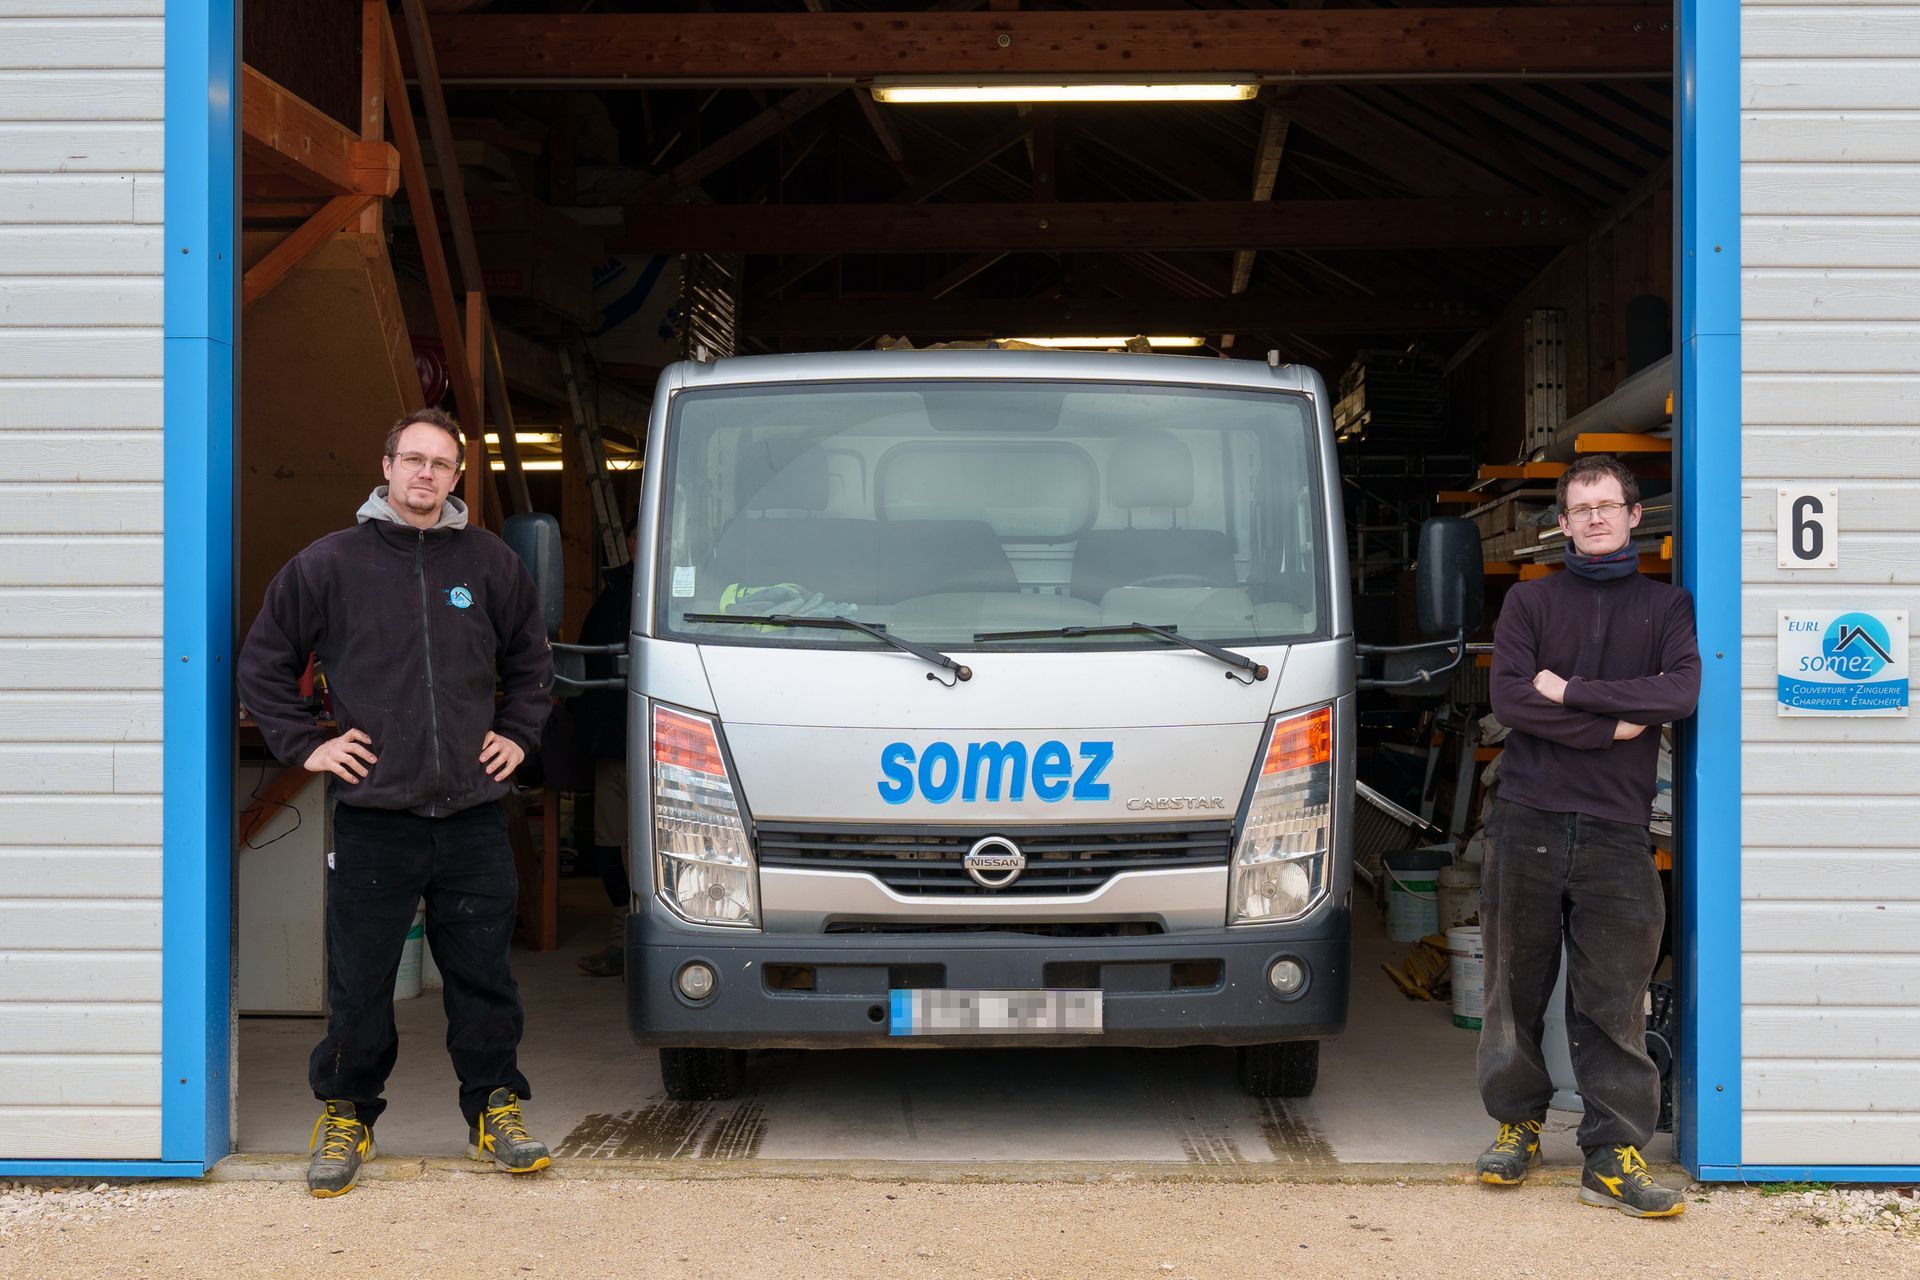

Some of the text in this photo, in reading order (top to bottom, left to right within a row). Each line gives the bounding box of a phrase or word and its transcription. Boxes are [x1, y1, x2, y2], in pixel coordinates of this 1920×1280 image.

[1792, 495, 1824, 561] 6
[1788, 621, 1820, 632] EURL
[1799, 655, 1875, 672] somez
[1792, 685, 1901, 695] COUVERTURE ZINGUERIE
[1792, 694, 1902, 706] CHARPENTE ÉTANCHÉITÉ
[877, 740, 1114, 805] somez
[1126, 795, 1226, 810] CABSTAR
[971, 858, 1019, 867] NISSAN
